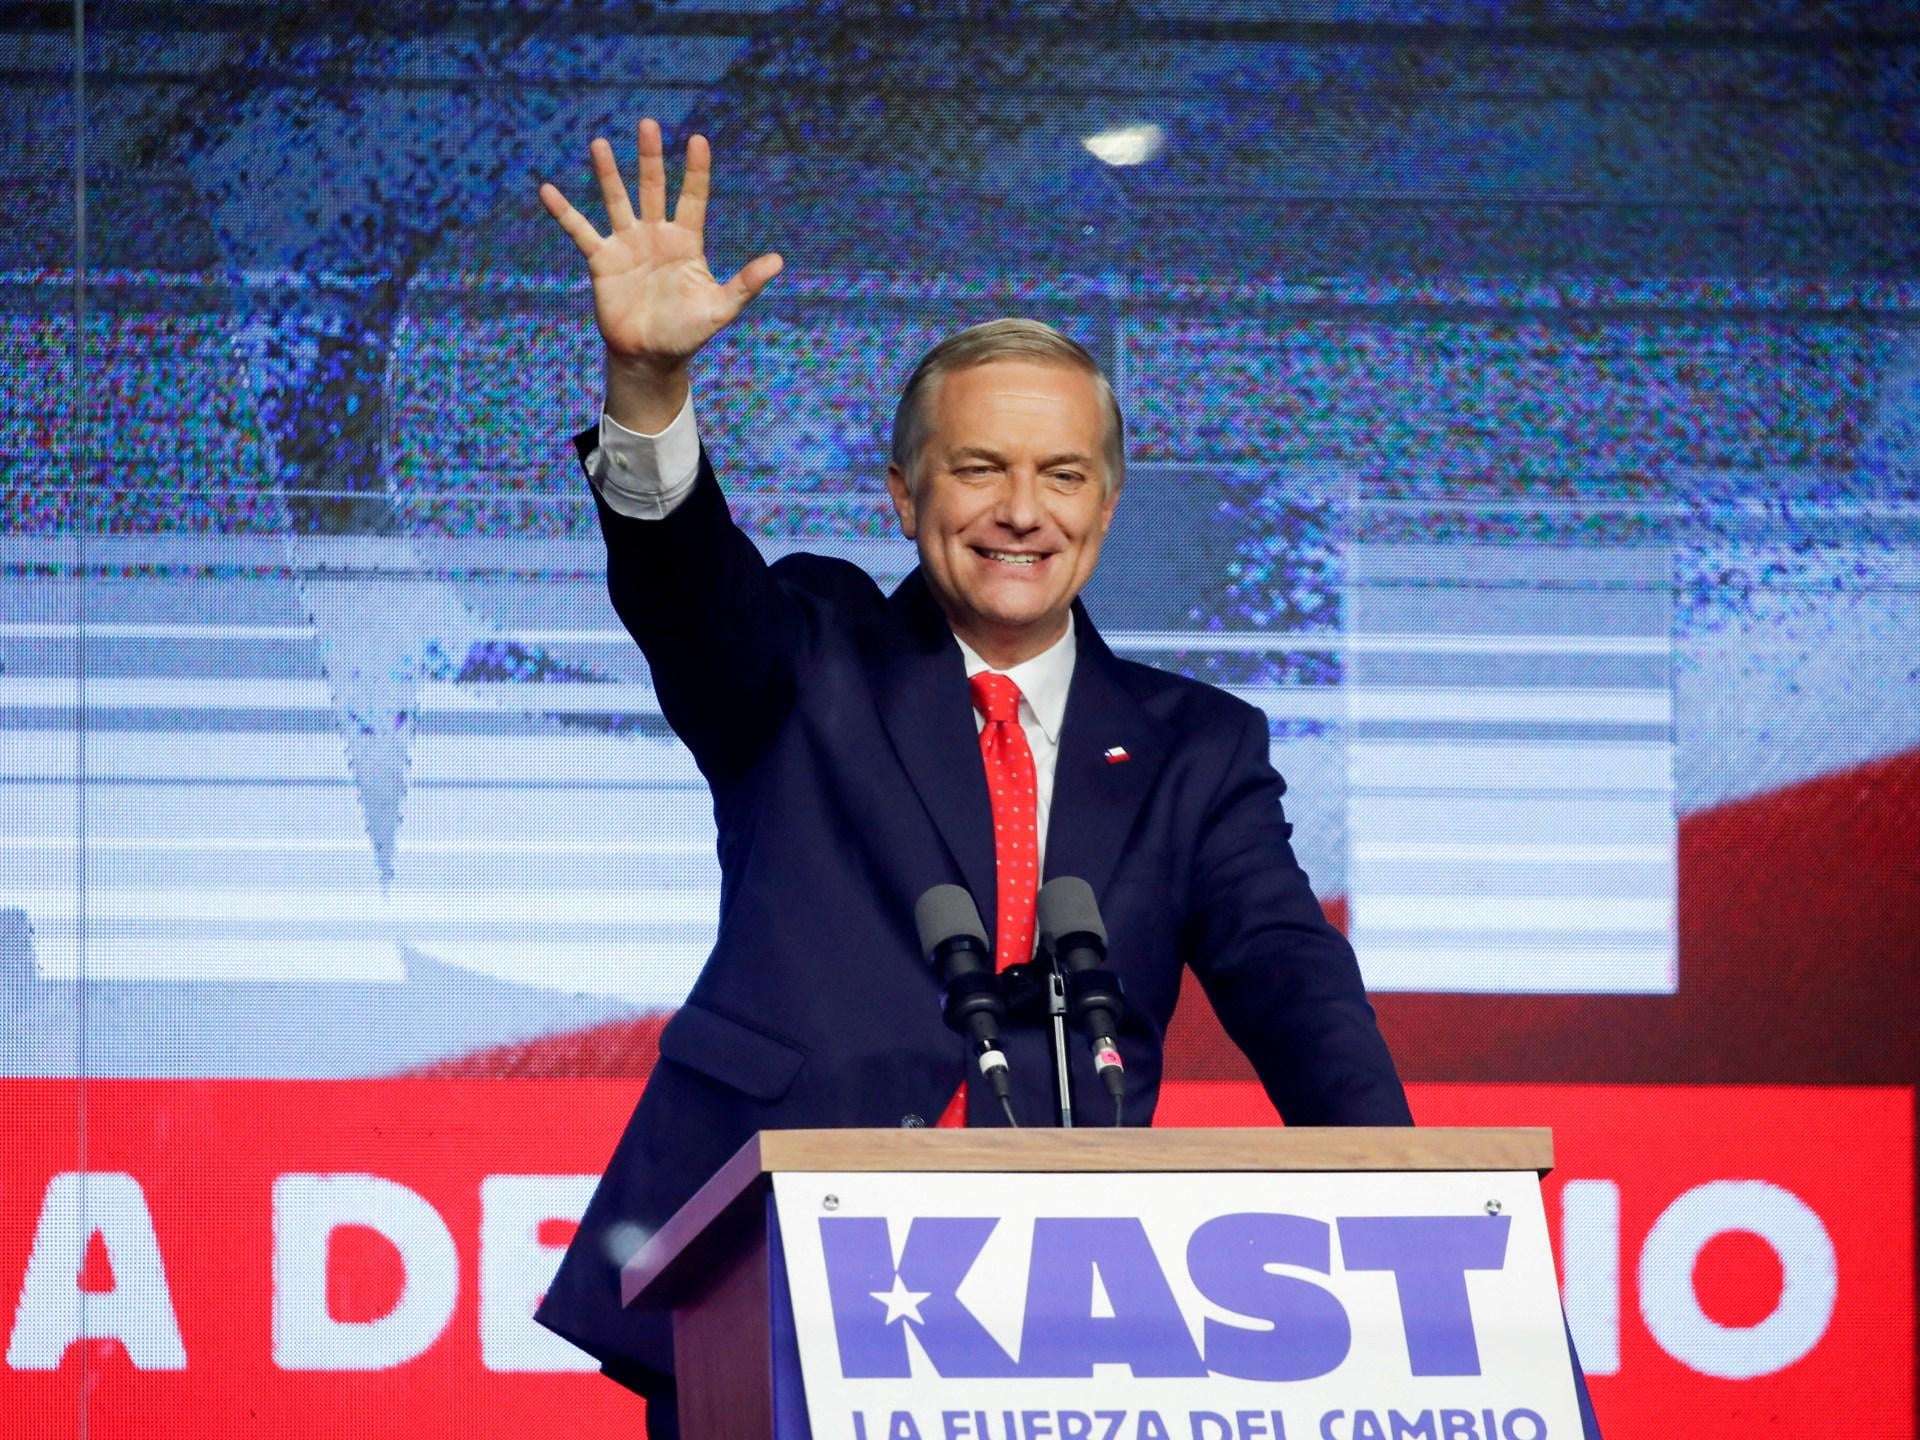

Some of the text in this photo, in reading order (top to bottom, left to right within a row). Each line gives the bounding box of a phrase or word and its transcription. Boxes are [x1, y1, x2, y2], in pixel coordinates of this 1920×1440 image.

[818, 1212, 1512, 1382] KAST
[942, 1410, 1170, 1440] FUERZA
[1319, 1408, 1548, 1440] CAMBIO
